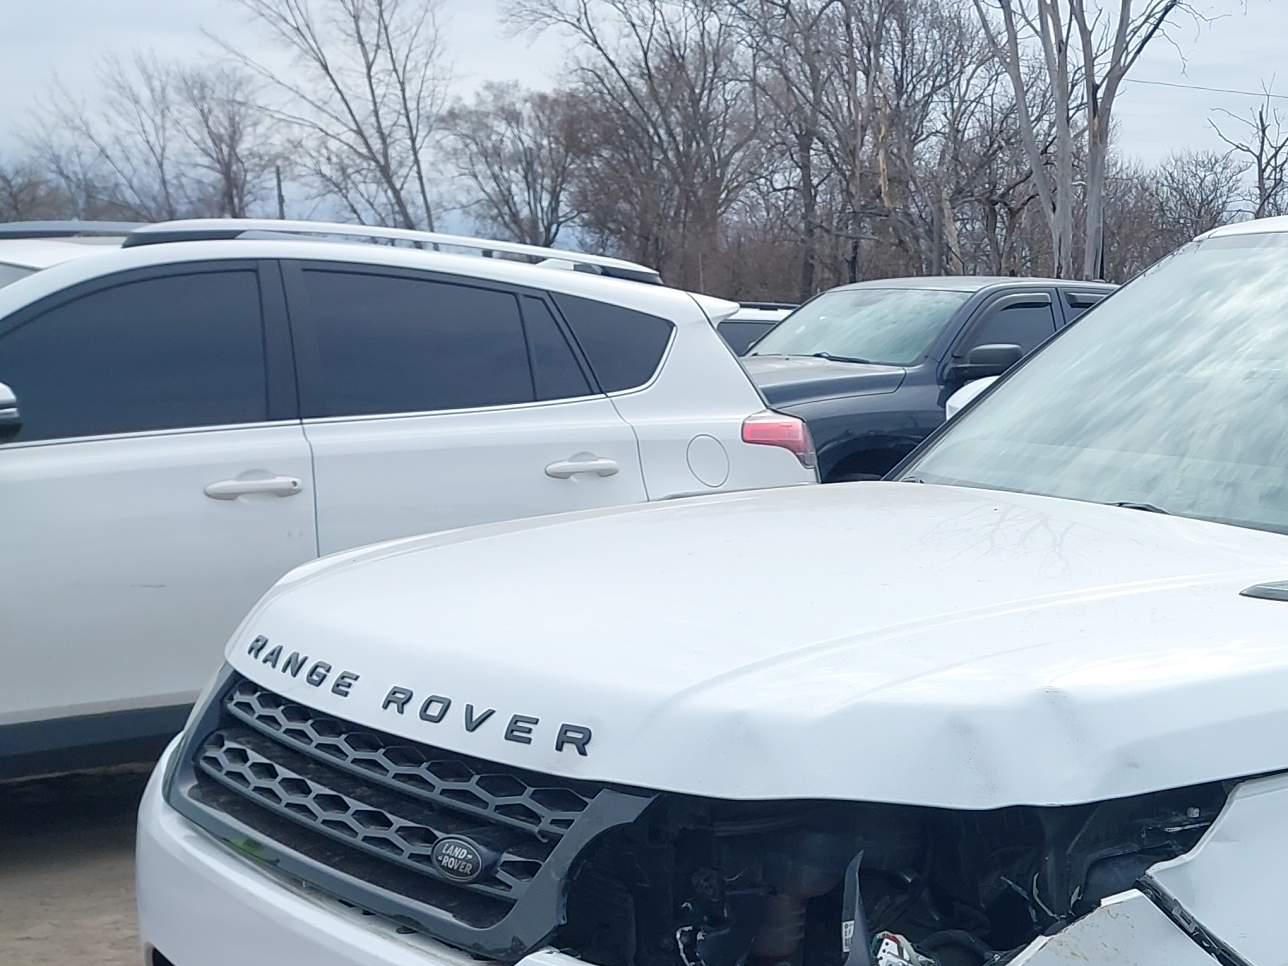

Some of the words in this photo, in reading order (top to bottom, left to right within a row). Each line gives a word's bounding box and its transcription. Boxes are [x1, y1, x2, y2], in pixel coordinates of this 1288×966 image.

[247, 634, 360, 698] RANGE
[382, 686, 592, 757] ROVER
[441, 855, 473, 874] ROVER
